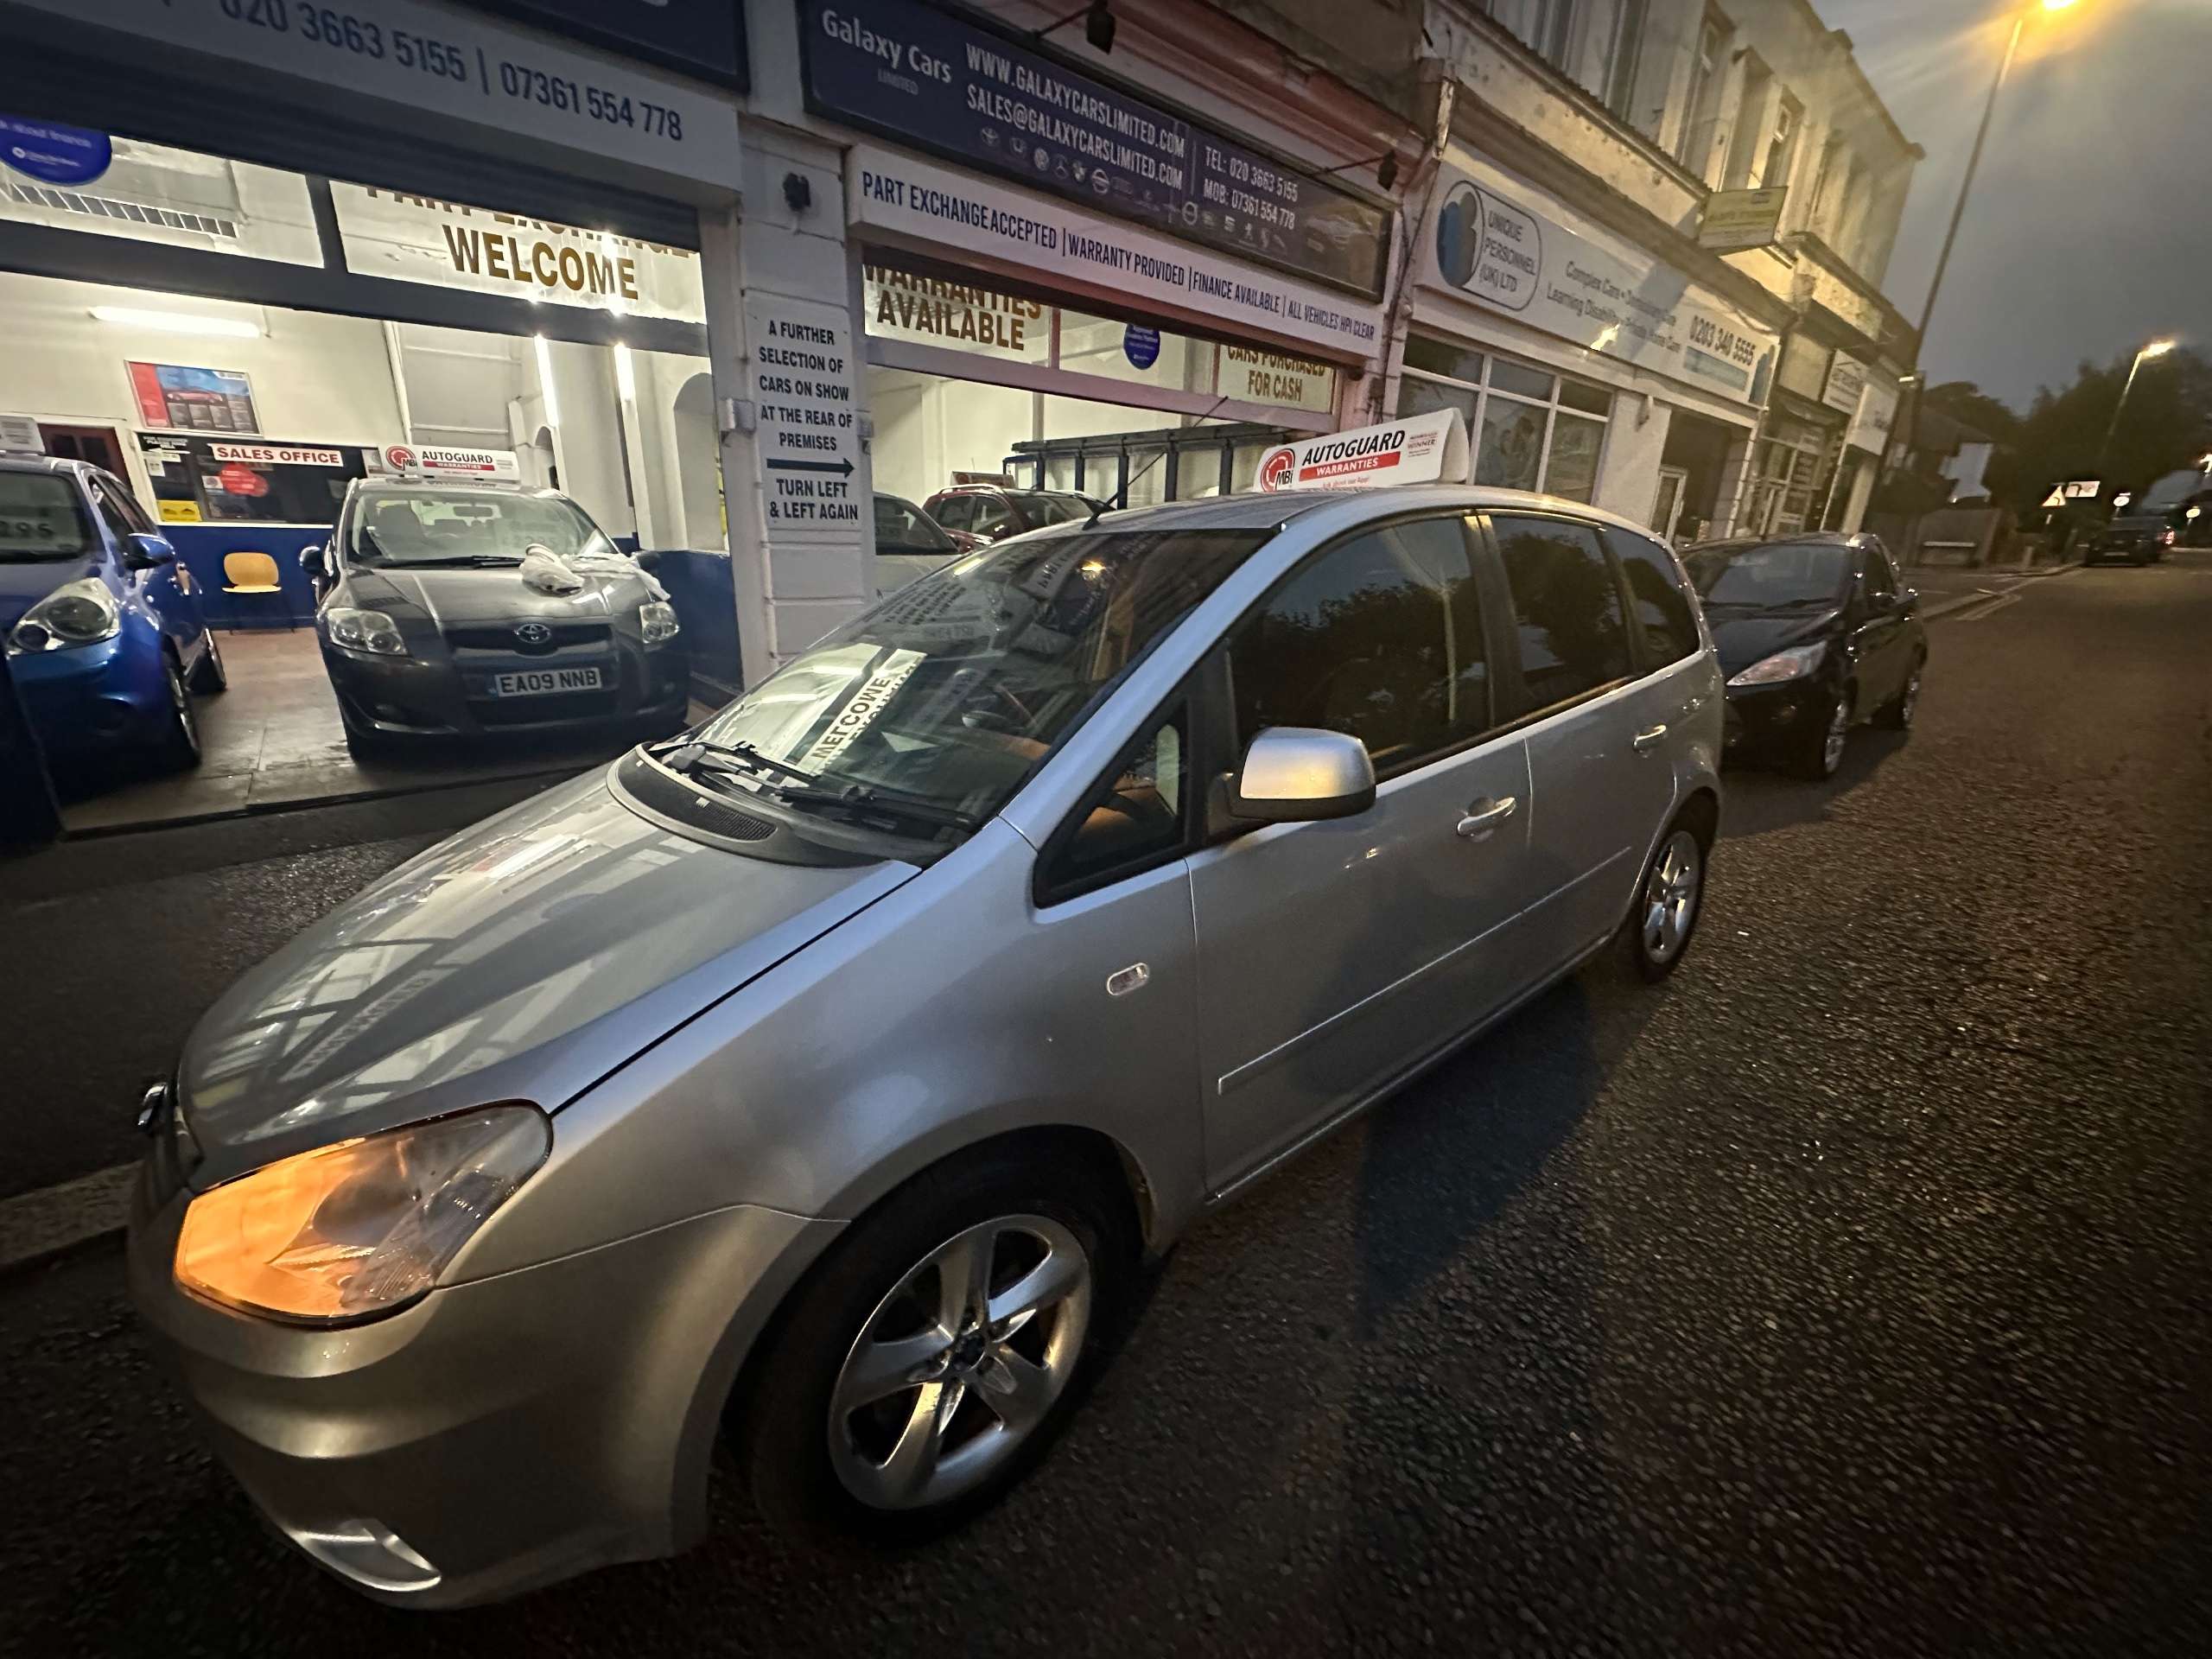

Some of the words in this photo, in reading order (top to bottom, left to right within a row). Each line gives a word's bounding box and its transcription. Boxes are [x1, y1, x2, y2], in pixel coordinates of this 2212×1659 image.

[822, 10, 901, 69] Galaxy
[908, 45, 951, 83] Cars
[298, 3, 385, 60] 3663
[392, 30, 467, 82] 5155
[500, 61, 581, 115] 07361
[587, 87, 634, 128] 554
[639, 101, 683, 141] 778
[966, 43, 1185, 158] WWW.GALAXYCARSLIMITED.COM
[967, 84, 1183, 190] SALES@GALAXYCARSLIMITED.COM
[1205, 145, 1226, 172] TEL:
[1230, 156, 1249, 182] 020
[1250, 166, 1274, 193] 3663
[1204, 178, 1230, 206] MOB:
[1231, 189, 1259, 215] 07361
[1260, 199, 1278, 224] 554
[1279, 206, 1295, 230] 778
[442, 224, 639, 301] WELCOME
[862, 171, 905, 206] PART
[910, 186, 988, 229] EXCHANGE
[990, 210, 1057, 250] ACCEPTED
[1068, 233, 1133, 270] WARRANTY
[1135, 253, 1184, 286] PROVIDED
[1193, 271, 1232, 300] FINANCE
[1235, 284, 1280, 313] AVAILABLE
[1287, 302, 1301, 320] ALL
[1304, 305, 1338, 330] VEHICLES
[1340, 316, 1353, 333] HPI
[1353, 321, 1375, 340] CLEAR
[769, 320, 778, 335] A
[780, 321, 835, 346] FURTHER
[877, 289, 1025, 351] AVAILABLE
[760, 346, 825, 371] SELECTION
[829, 358, 843, 373] OF
[760, 375, 791, 394] CARS
[795, 380, 812, 397] ON
[816, 383, 849, 401] SHOW
[1248, 369, 1270, 397] FOR
[1274, 374, 1302, 401] CASH
[760, 405, 775, 421] AT
[778, 406, 803, 423] THE
[805, 409, 836, 427] REAR
[838, 413, 853, 428] OF
[217, 447, 274, 461] SALES
[280, 450, 340, 464] OFFICE
[779, 432, 837, 451] PREMISES
[1301, 429, 1406, 466] AUTOGUARD
[422, 451, 493, 464] AUTOGUARD
[1316, 458, 1379, 476] WARRANTIES
[776, 479, 813, 497] TURN
[817, 480, 848, 498] LEFT
[769, 501, 779, 518] &
[784, 502, 815, 518] LEFT
[819, 504, 858, 519] AGAIN
[499, 673, 555, 693] EA09
[558, 671, 598, 689] NNB
